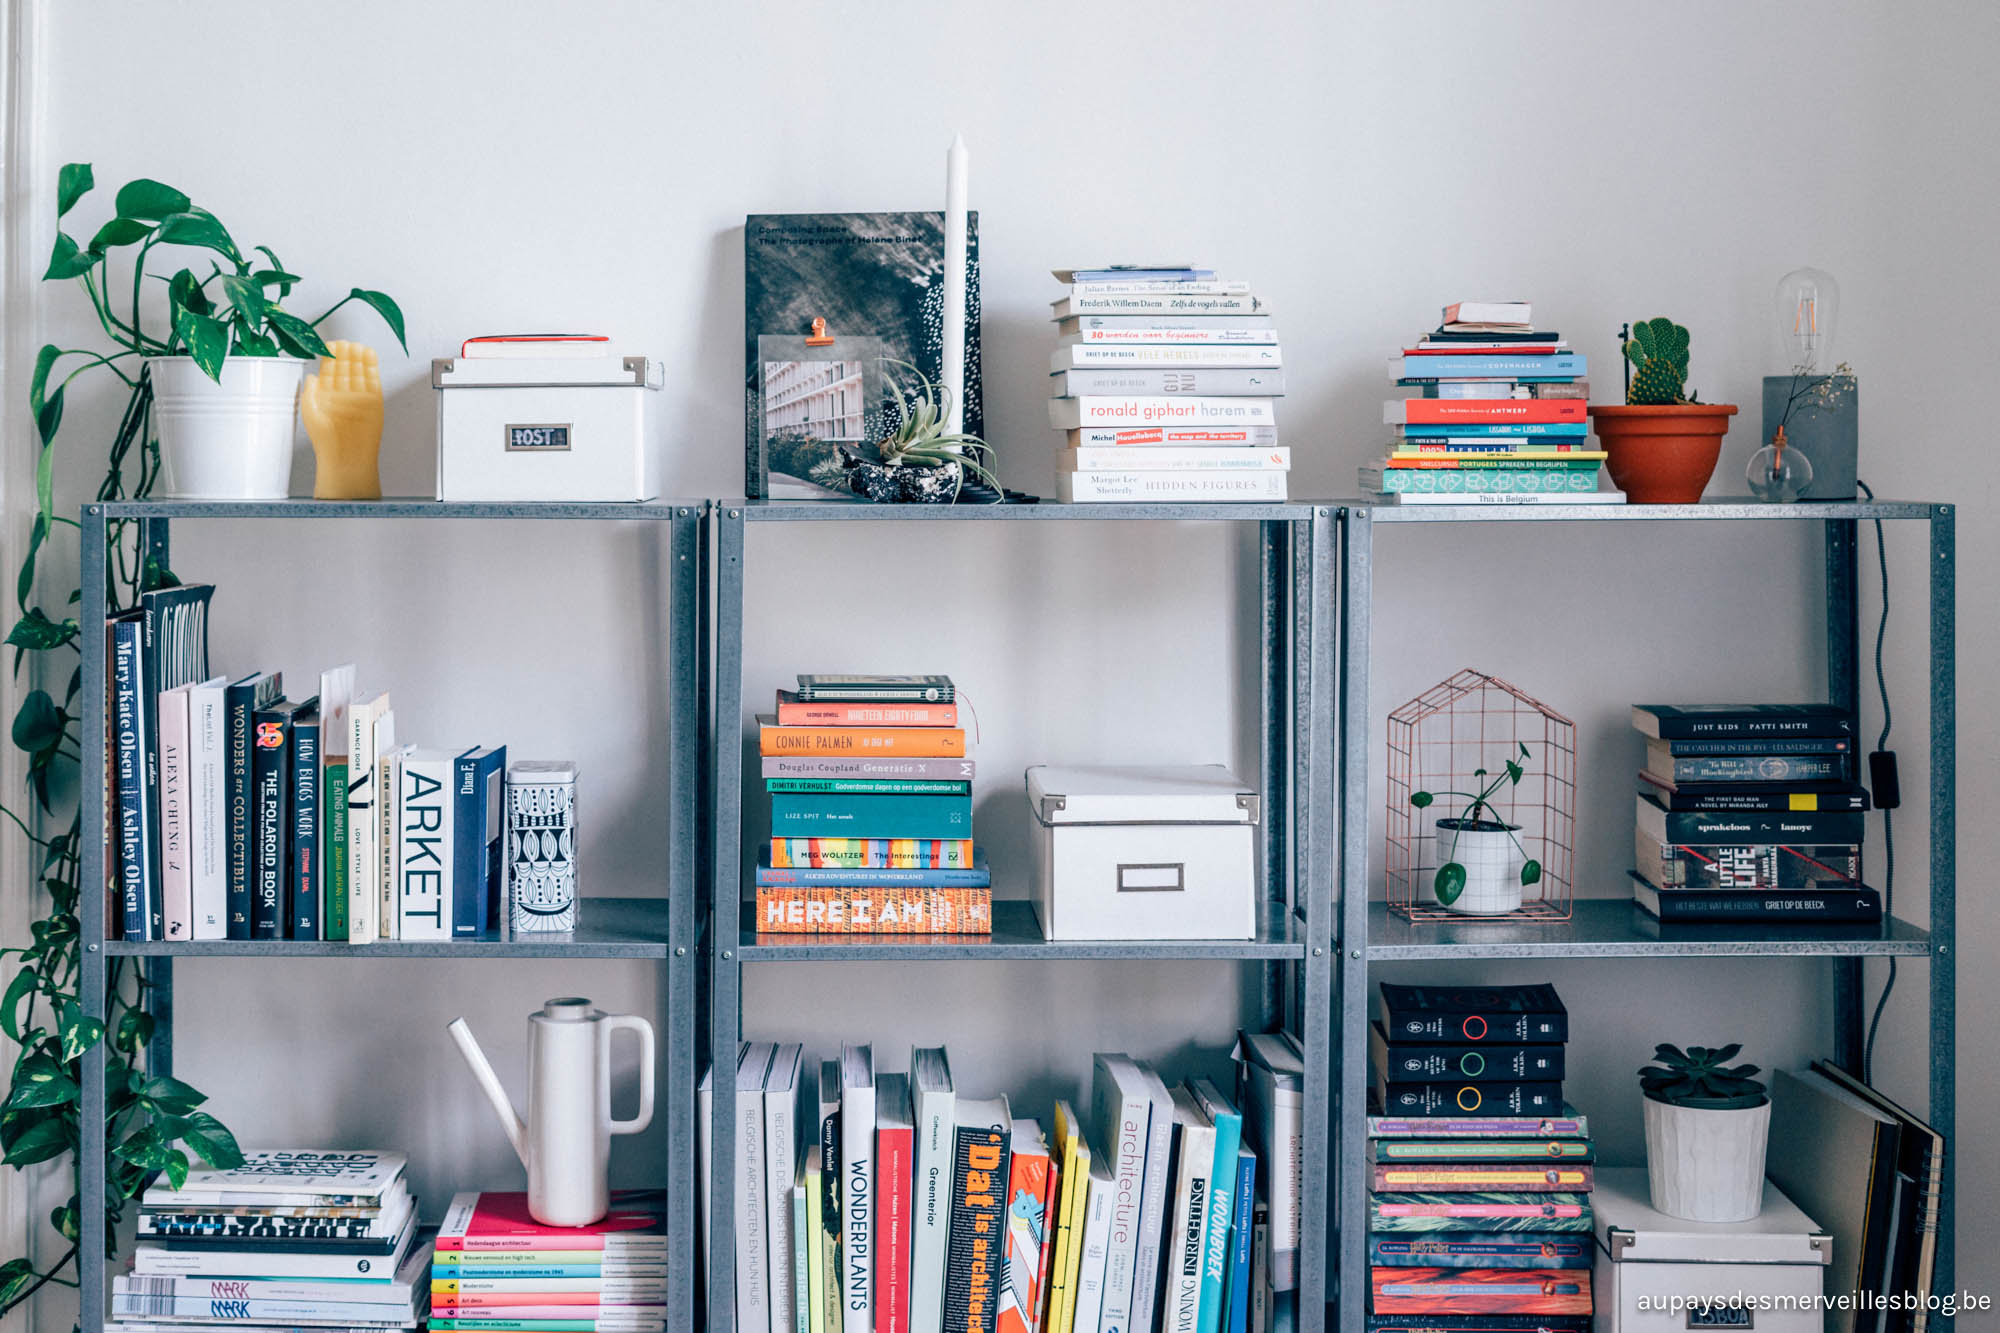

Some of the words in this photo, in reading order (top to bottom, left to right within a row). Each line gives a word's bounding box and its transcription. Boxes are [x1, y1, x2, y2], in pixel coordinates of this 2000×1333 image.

[758, 226, 813, 236] Composing
[816, 226, 848, 236] Space
[758, 238, 777, 246] The
[895, 234, 922, 244] Binet
[1079, 299, 1111, 308] Frederik
[1112, 299, 1140, 308] Willem
[1140, 299, 1163, 308] Daem
[1170, 299, 1186, 309] Zelfs
[1187, 299, 1197, 308] de
[1197, 299, 1218, 310] vogels
[1218, 299, 1241, 308] vallen
[1091, 331, 1103, 340] 30
[1090, 401, 1138, 417] ronald
[1143, 401, 1196, 420] giphart
[1200, 402, 1246, 417] harem
[1523, 426, 1546, 434] LISBOA
[1535, 461, 1568, 469] BEGRIJPEN
[1123, 475, 1138, 484] Lee
[1145, 481, 1198, 490] HIDDEN
[1203, 480, 1257, 490] FIGURES
[1479, 495, 1495, 503] This
[1496, 495, 1504, 503] is
[1505, 495, 1539, 505] Belgium
[116, 640, 134, 729] Mary-Kate
[232, 703, 246, 776] WONDERS
[1692, 723, 1714, 732] JUST
[1717, 723, 1739, 731] KIDS
[1749, 722, 1776, 730] PATTI
[1780, 722, 1808, 730] SMITH
[298, 739, 314, 762] HOW
[776, 735, 810, 749] CONNIE
[816, 735, 853, 749] PALMEN
[1676, 744, 1690, 752] THE
[1691, 744, 1725, 752] CATCHER
[1727, 744, 1736, 752] IN
[119, 731, 135, 779] Olsen
[1720, 760, 1737, 768] Kill
[166, 744, 178, 796] ALEXA
[779, 763, 814, 773] Douglas
[817, 763, 860, 773] Coupland
[863, 763, 913, 773] Generatie
[917, 764, 927, 773] X
[1700, 768, 1753, 778] Mockingbird
[1818, 763, 1831, 773] LEE
[234, 777, 245, 793] are
[265, 769, 278, 797] THE
[298, 768, 314, 801] BLOGS
[333, 779, 345, 810] EATING
[460, 773, 474, 795] Diana
[798, 782, 832, 790] VERHULST
[874, 784, 892, 792] dagen
[121, 805, 140, 862] Ashley
[167, 798, 180, 852] CHUNG
[264, 800, 278, 867] POLAROID
[297, 807, 314, 839] WORK
[333, 811, 344, 842] ANIMALS
[1698, 823, 1751, 832] sprakeloos
[1781, 823, 1813, 832] lanoye
[232, 796, 246, 894] COLLECTIBLE
[405, 769, 443, 929] ARKET
[874, 852, 890, 860] The
[891, 852, 940, 860] Interestings
[1704, 862, 1718, 873] A
[1719, 848, 1733, 888] LITTLE
[1734, 848, 1757, 888] LIFE
[1770, 847, 1778, 888] YANAGIHARA
[125, 863, 141, 914] Olsen
[263, 870, 277, 908] BOOK
[334, 896, 344, 915] FOER
[767, 900, 844, 924] HERE
[851, 900, 873, 924] I
[879, 900, 923, 923] AM
[1765, 900, 1784, 910] GRIET
[1785, 900, 1794, 909] OP
[1795, 900, 1804, 909] DE
[1804, 900, 1825, 909] BEECK
[745, 1108, 756, 1164] BELGISCHE
[774, 1112, 785, 1168] BELGISCHE
[825, 1119, 834, 1144] Danny
[1155, 1122, 1168, 1147] Glas
[826, 1146, 834, 1172] Venlet
[1154, 1150, 1166, 1161] in
[1288, 1135, 1296, 1198] ARCHITECTUUR
[1114, 1119, 1143, 1244] architecture
[747, 1166, 758, 1237] ARCHITECTEN
[775, 1170, 787, 1228] DESIGNERS
[927, 1166, 939, 1227] Greenterior
[1146, 1163, 1164, 1235] architectuur
[891, 1220, 899, 1245] Maisons
[974, 1213, 994, 1232] is
[1184, 1179, 1204, 1275] INRICHTING
[748, 1239, 759, 1253] EN
[777, 1230, 788, 1244] EN
[850, 1159, 868, 1312] WONDERPLANTS
[1206, 1188, 1230, 1284] WOONBOEK
[748, 1256, 759, 1280] HUN
[777, 1246, 788, 1270] HUN
[210, 1282, 250, 1300] MARK
[749, 1282, 760, 1306] HUIS
[778, 1272, 789, 1325] INTERIEUR
[210, 1300, 250, 1318] MARK
[829, 1300, 837, 1326] designer
[1178, 1279, 1196, 1332] WONING
